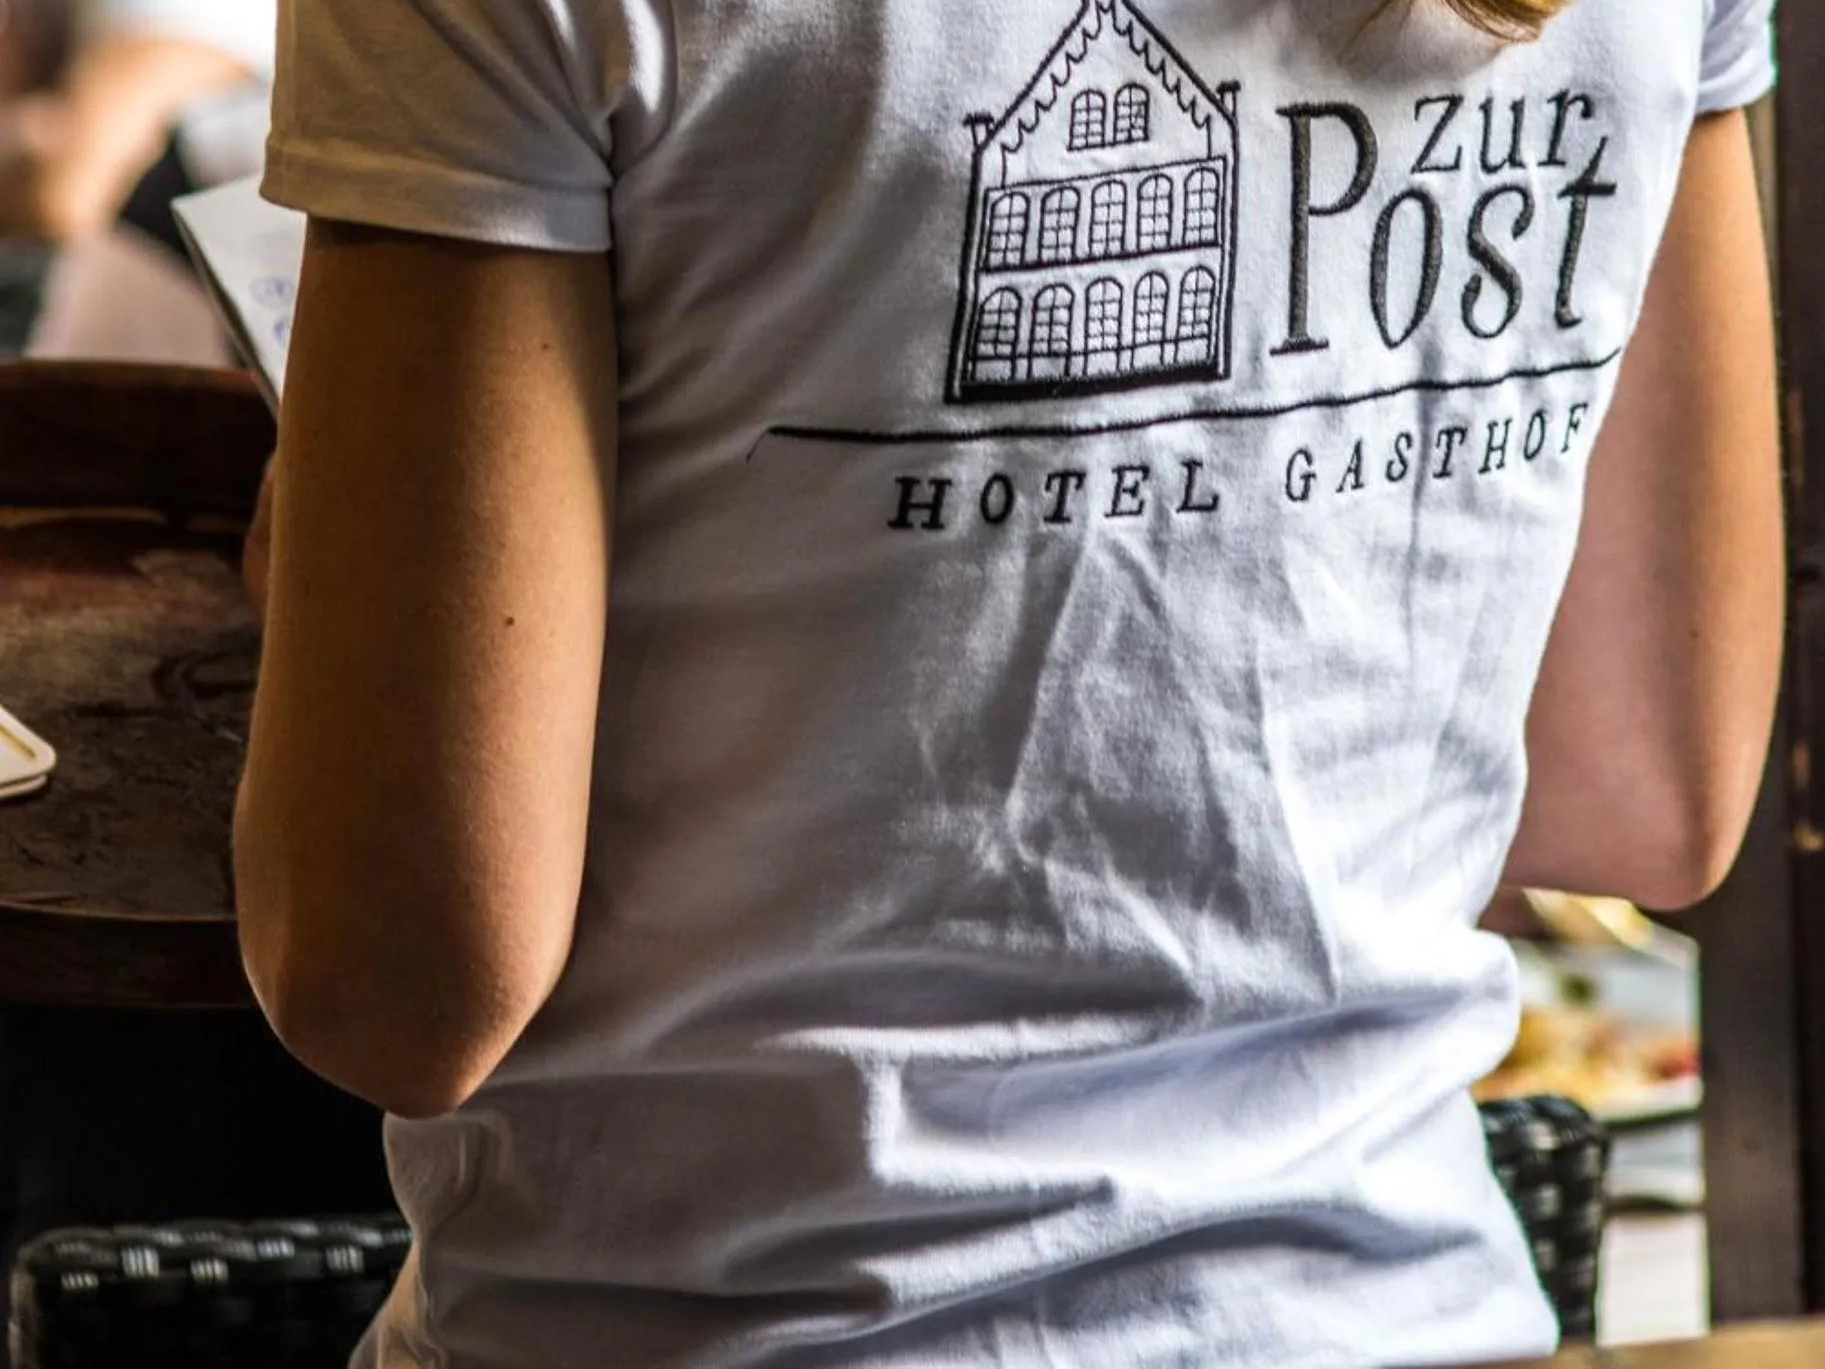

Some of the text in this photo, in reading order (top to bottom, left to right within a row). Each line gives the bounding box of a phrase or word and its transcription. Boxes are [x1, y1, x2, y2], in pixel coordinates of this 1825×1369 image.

[1410, 88, 1594, 175] zur
[1270, 102, 1616, 356] Post
[887, 402, 1589, 530] HOTEL GASTHOF
